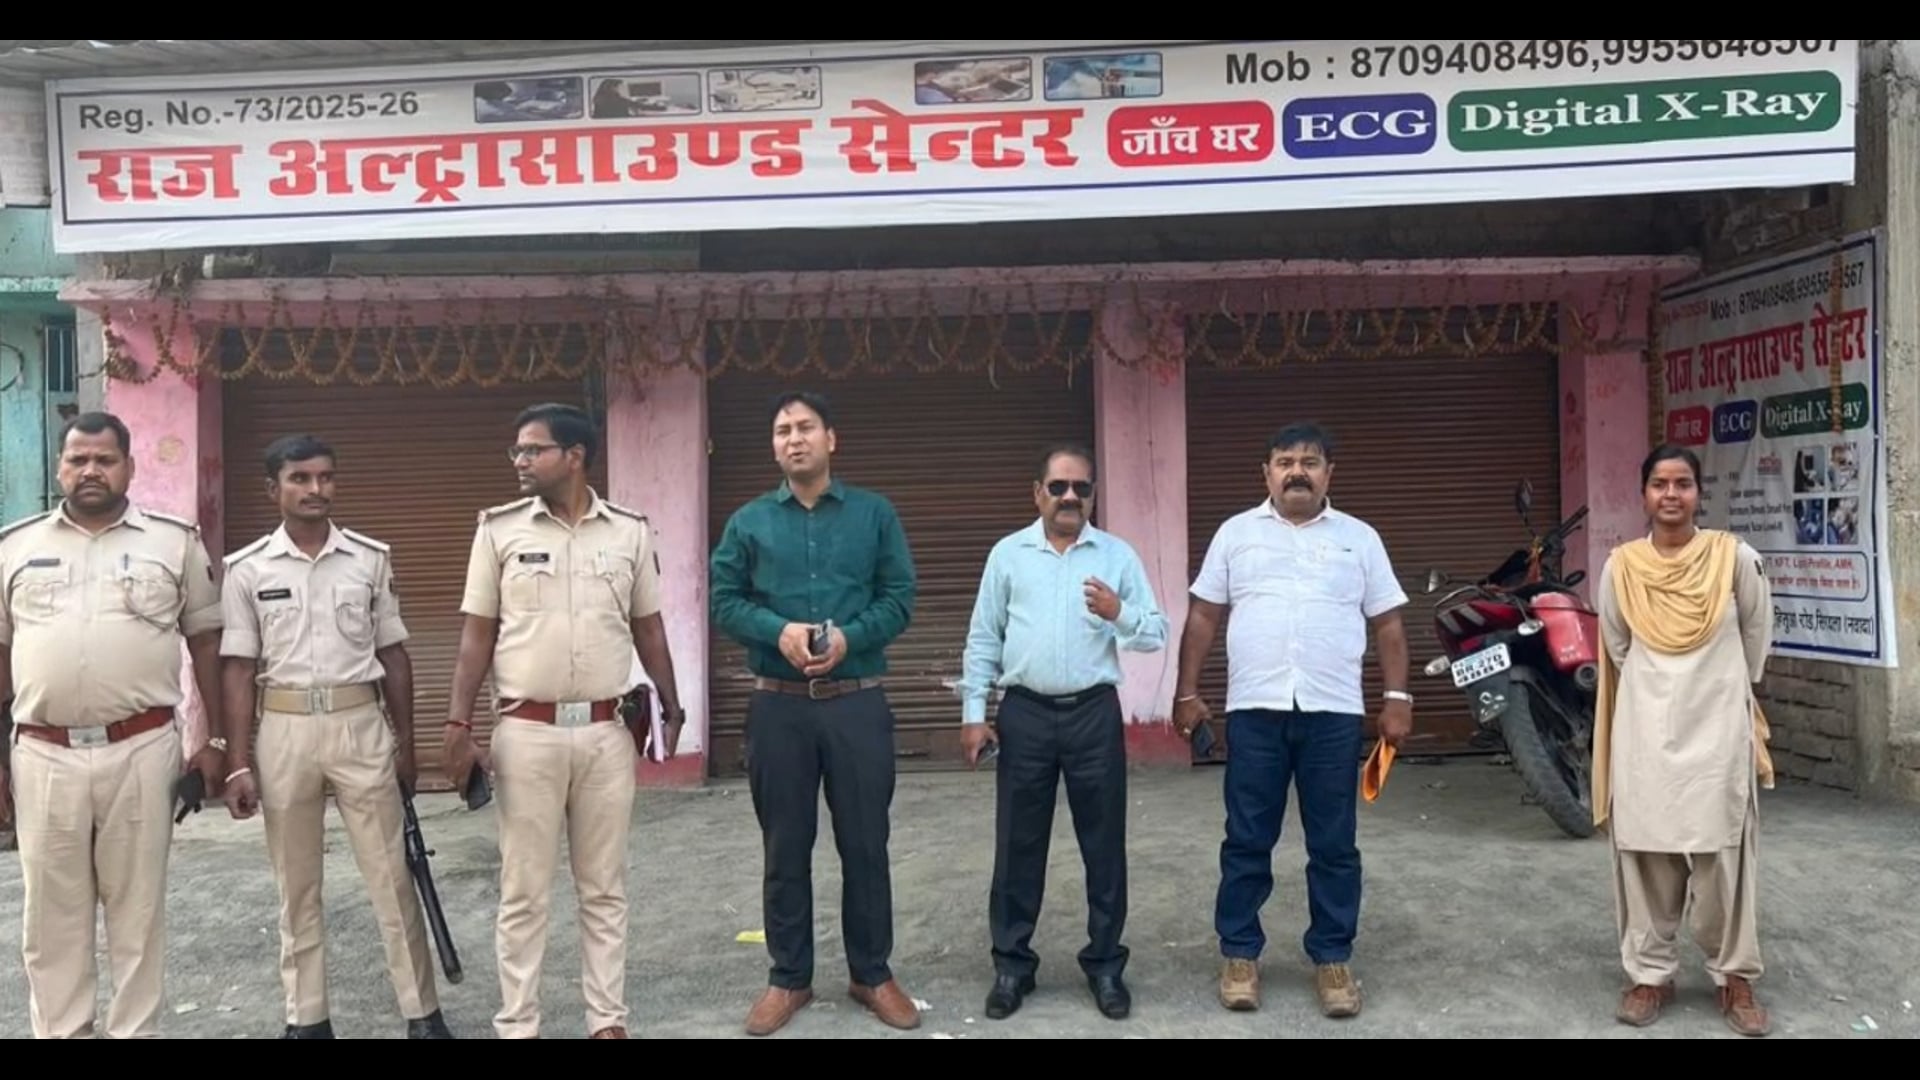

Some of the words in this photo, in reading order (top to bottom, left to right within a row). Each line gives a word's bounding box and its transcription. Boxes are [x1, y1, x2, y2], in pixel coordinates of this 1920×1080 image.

[1226, 51, 1310, 85] Mob
[79, 102, 153, 134] Reg.
[166, 91, 419, 126] No.-73/2025-26
[1295, 109, 1431, 142] ECG
[1460, 93, 1642, 136] Digital
[1655, 89, 1828, 121] X-Ray
[77, 145, 243, 201] राज
[268, 119, 812, 203] अल्ट्रासाउण्ड
[831, 99, 1084, 173] सेन्टर
[1121, 116, 1198, 155] जाँच
[1211, 122, 1261, 153] घर
[1664, 346, 1694, 395] राज
[1719, 412, 1752, 433] ECG
[1765, 401, 1813, 429] Digital
[1816, 400, 1863, 424] X-ay
